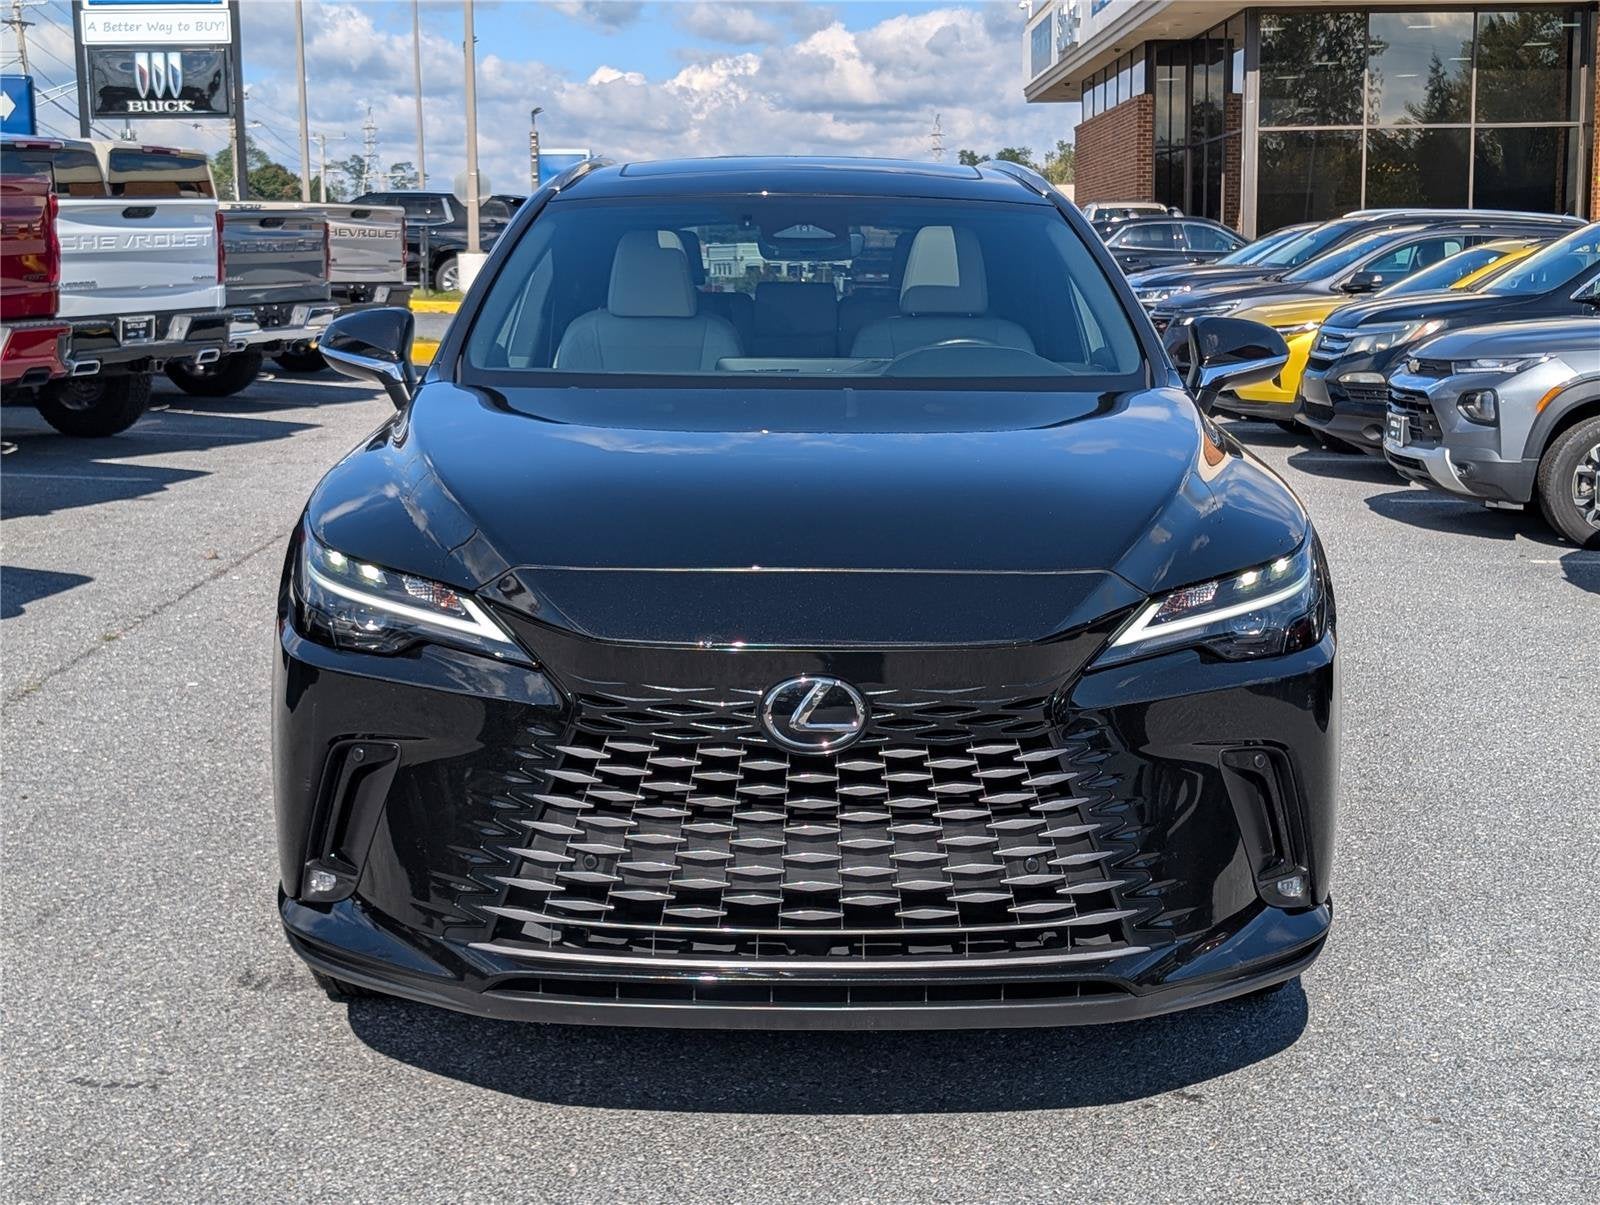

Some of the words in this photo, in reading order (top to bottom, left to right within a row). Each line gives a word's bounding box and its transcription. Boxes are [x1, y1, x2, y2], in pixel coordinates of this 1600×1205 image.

[87, 21, 97, 32] A
[103, 21, 142, 32] Better
[147, 21, 173, 35] Way
[178, 22, 191, 32] to
[195, 21, 225, 32] BUY!
[127, 100, 194, 113] BUICK
[330, 228, 401, 239] HEVROLET
